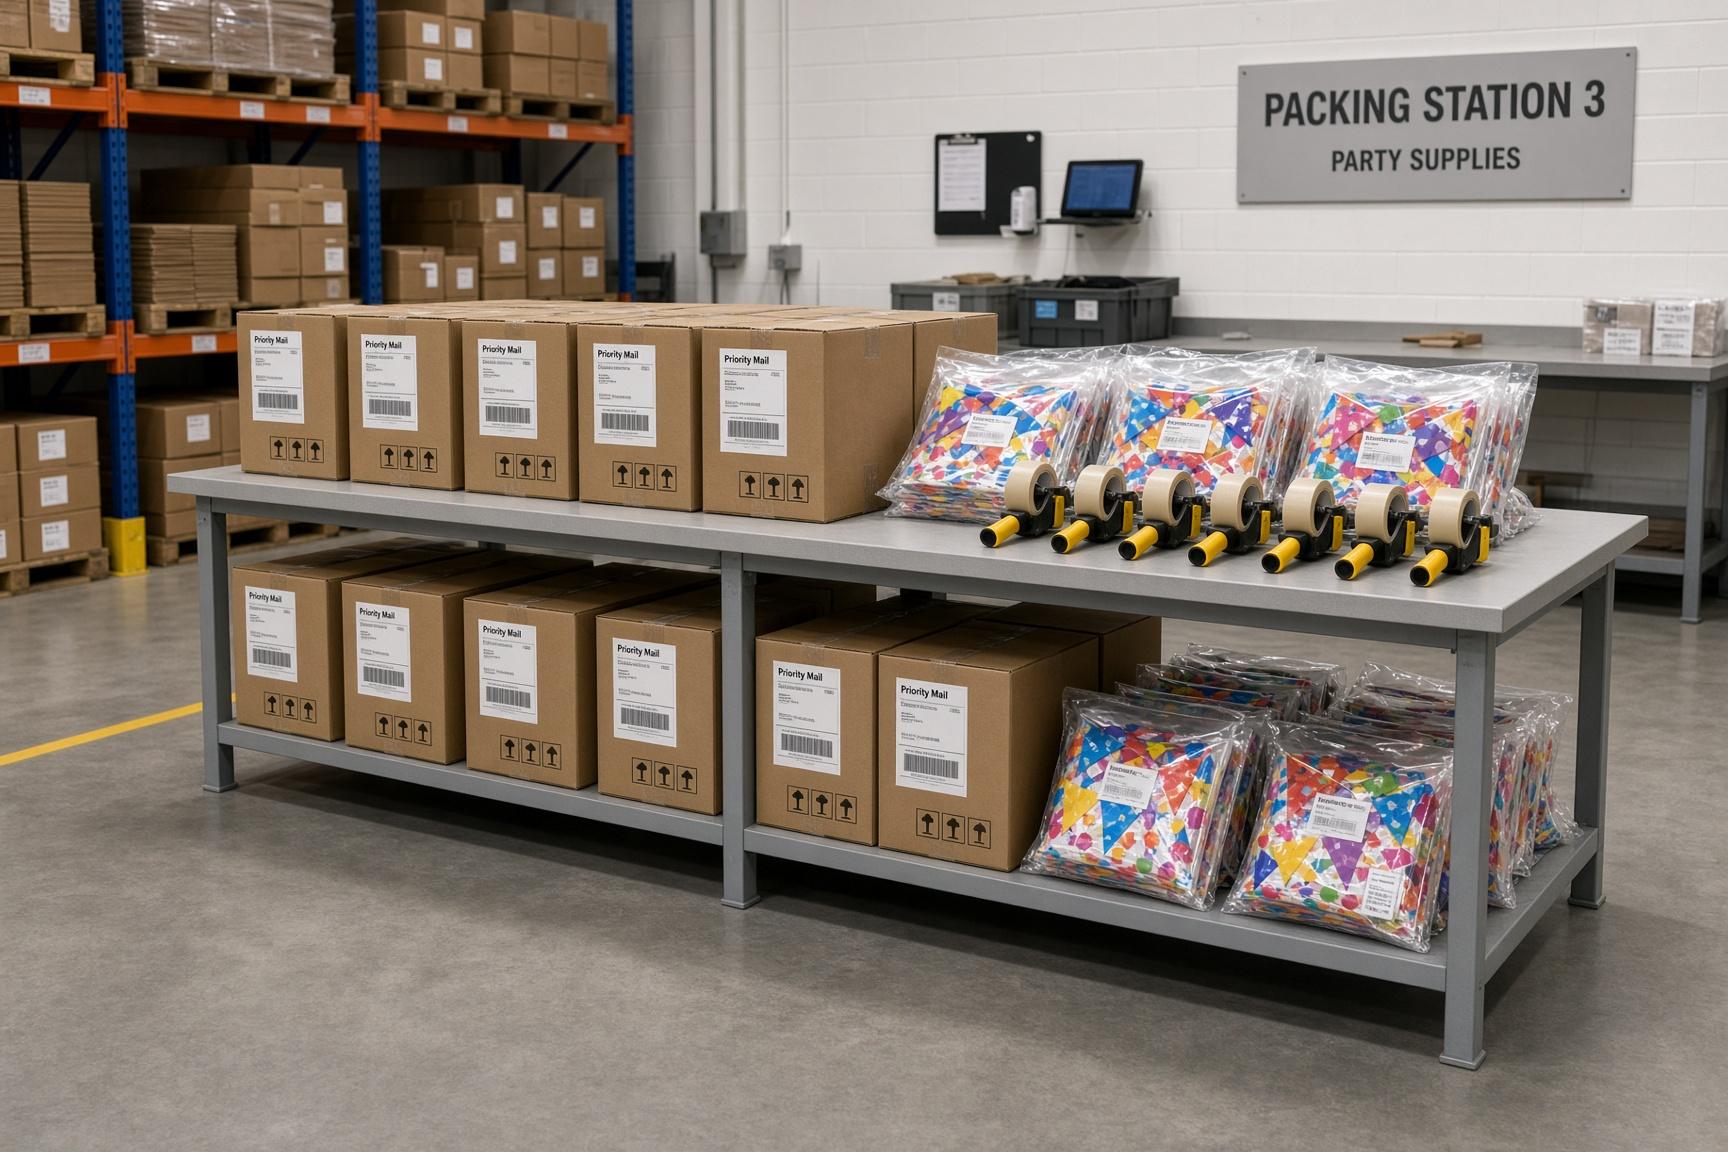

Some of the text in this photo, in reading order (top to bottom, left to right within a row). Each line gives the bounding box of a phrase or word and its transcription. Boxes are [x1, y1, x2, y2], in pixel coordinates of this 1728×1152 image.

[1266, 80, 1605, 127] PACKING STATION 3
[1332, 147, 1521, 172] PARTY SUPPLIES
[254, 335, 288, 346] Priority Mail
[365, 340, 402, 351] Priority Mail
[482, 344, 522, 356] Priority Mail
[597, 349, 639, 360] Priority Mail
[724, 354, 770, 366] Priority Mail
[248, 591, 282, 603] Priority Mail
[359, 607, 395, 620] Priority Mail
[482, 625, 522, 638] Priority Mail
[617, 643, 660, 658] Priority Mail
[778, 667, 823, 682] Priority Mail
[900, 685, 948, 700] Priority Mail
